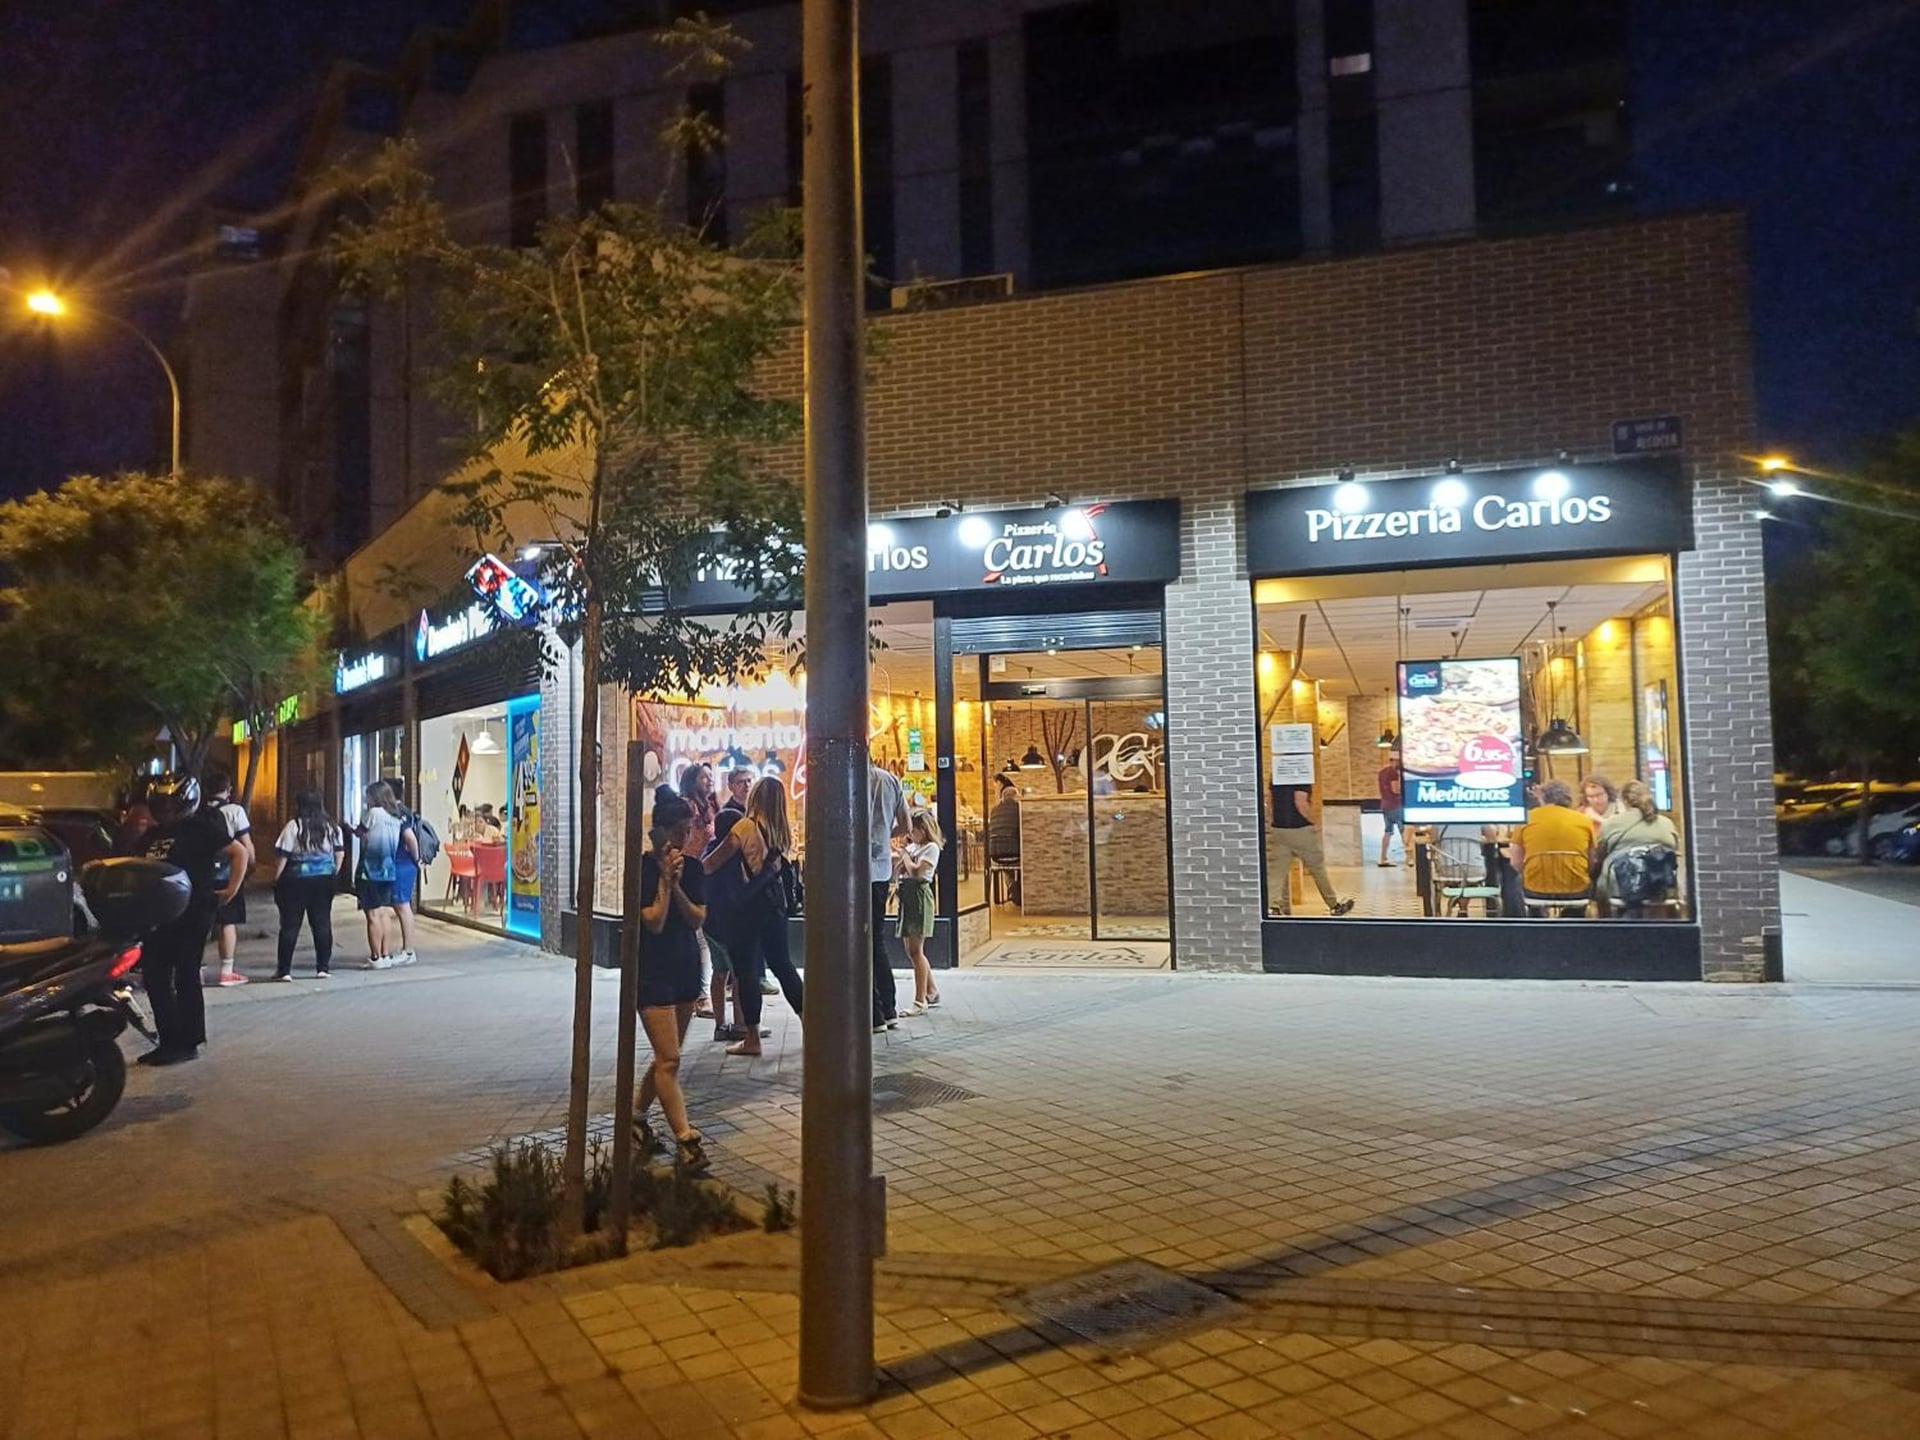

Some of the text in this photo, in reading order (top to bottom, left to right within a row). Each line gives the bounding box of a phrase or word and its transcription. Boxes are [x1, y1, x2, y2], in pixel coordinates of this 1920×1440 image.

[1473, 495, 1611, 531] Carlos
[867, 545, 928, 573] rlos
[984, 532, 1106, 572] Carlos
[1417, 784, 1510, 803] Medianas
